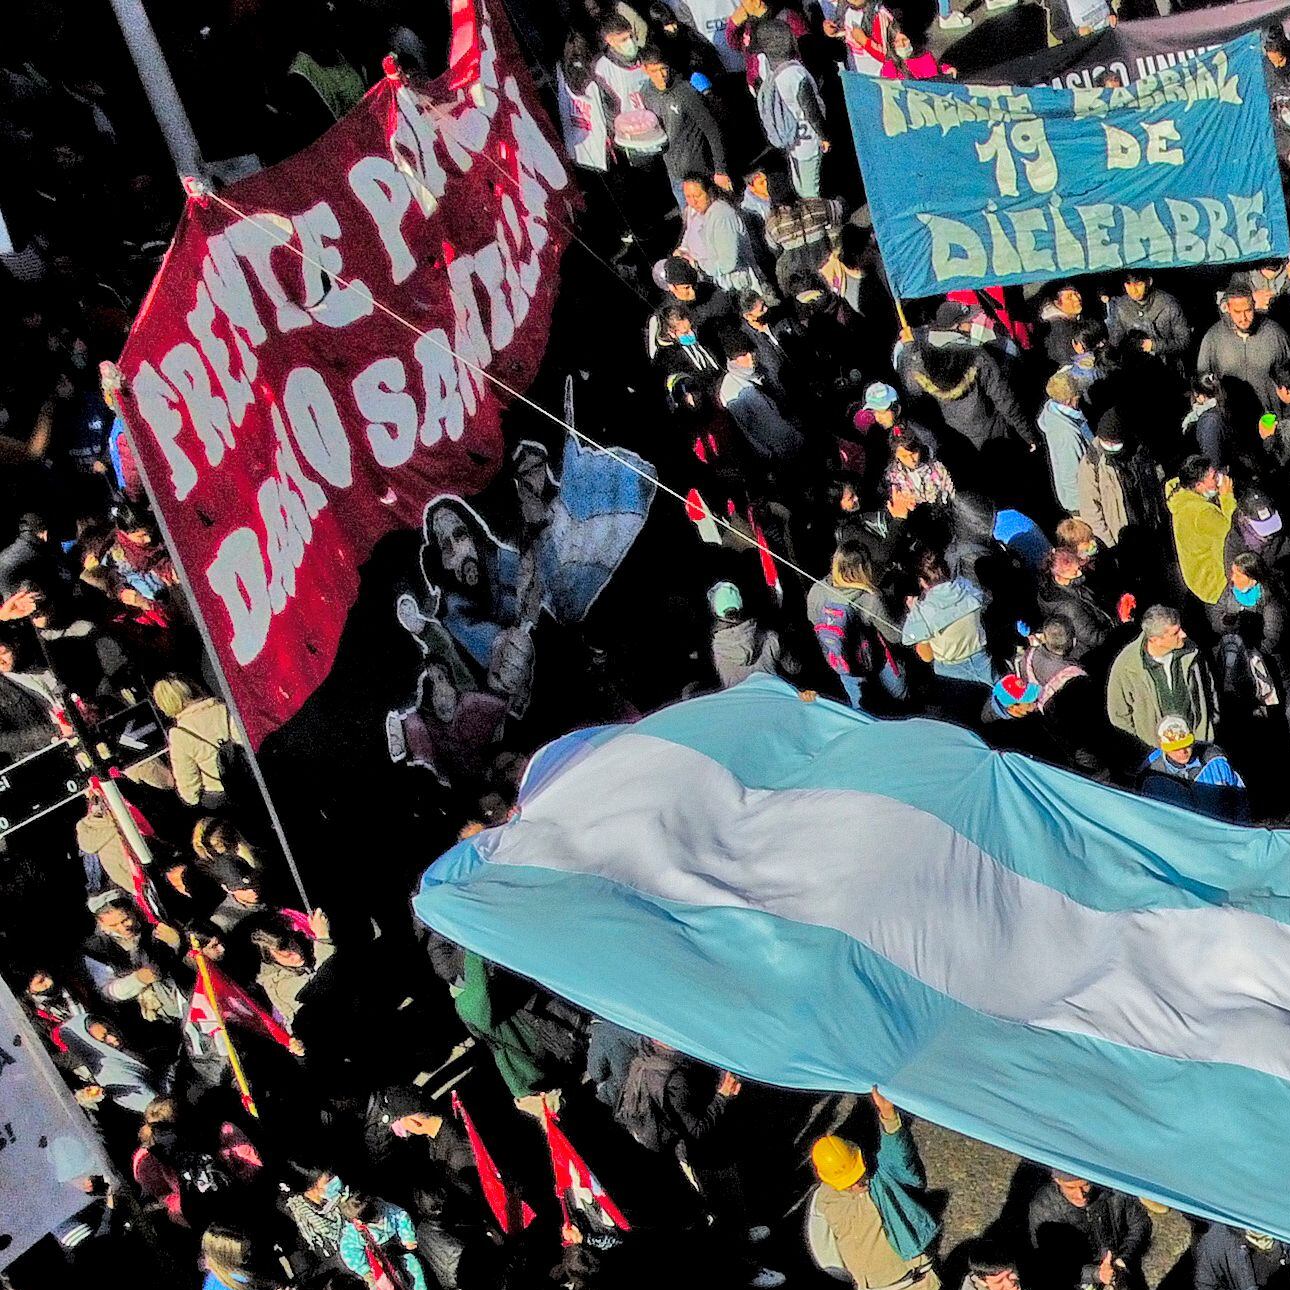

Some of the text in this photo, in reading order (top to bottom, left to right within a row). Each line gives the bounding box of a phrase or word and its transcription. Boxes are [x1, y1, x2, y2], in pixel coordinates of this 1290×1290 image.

[975, 118, 1184, 197] 19 DE
[133, 201, 374, 501] FRENTE
